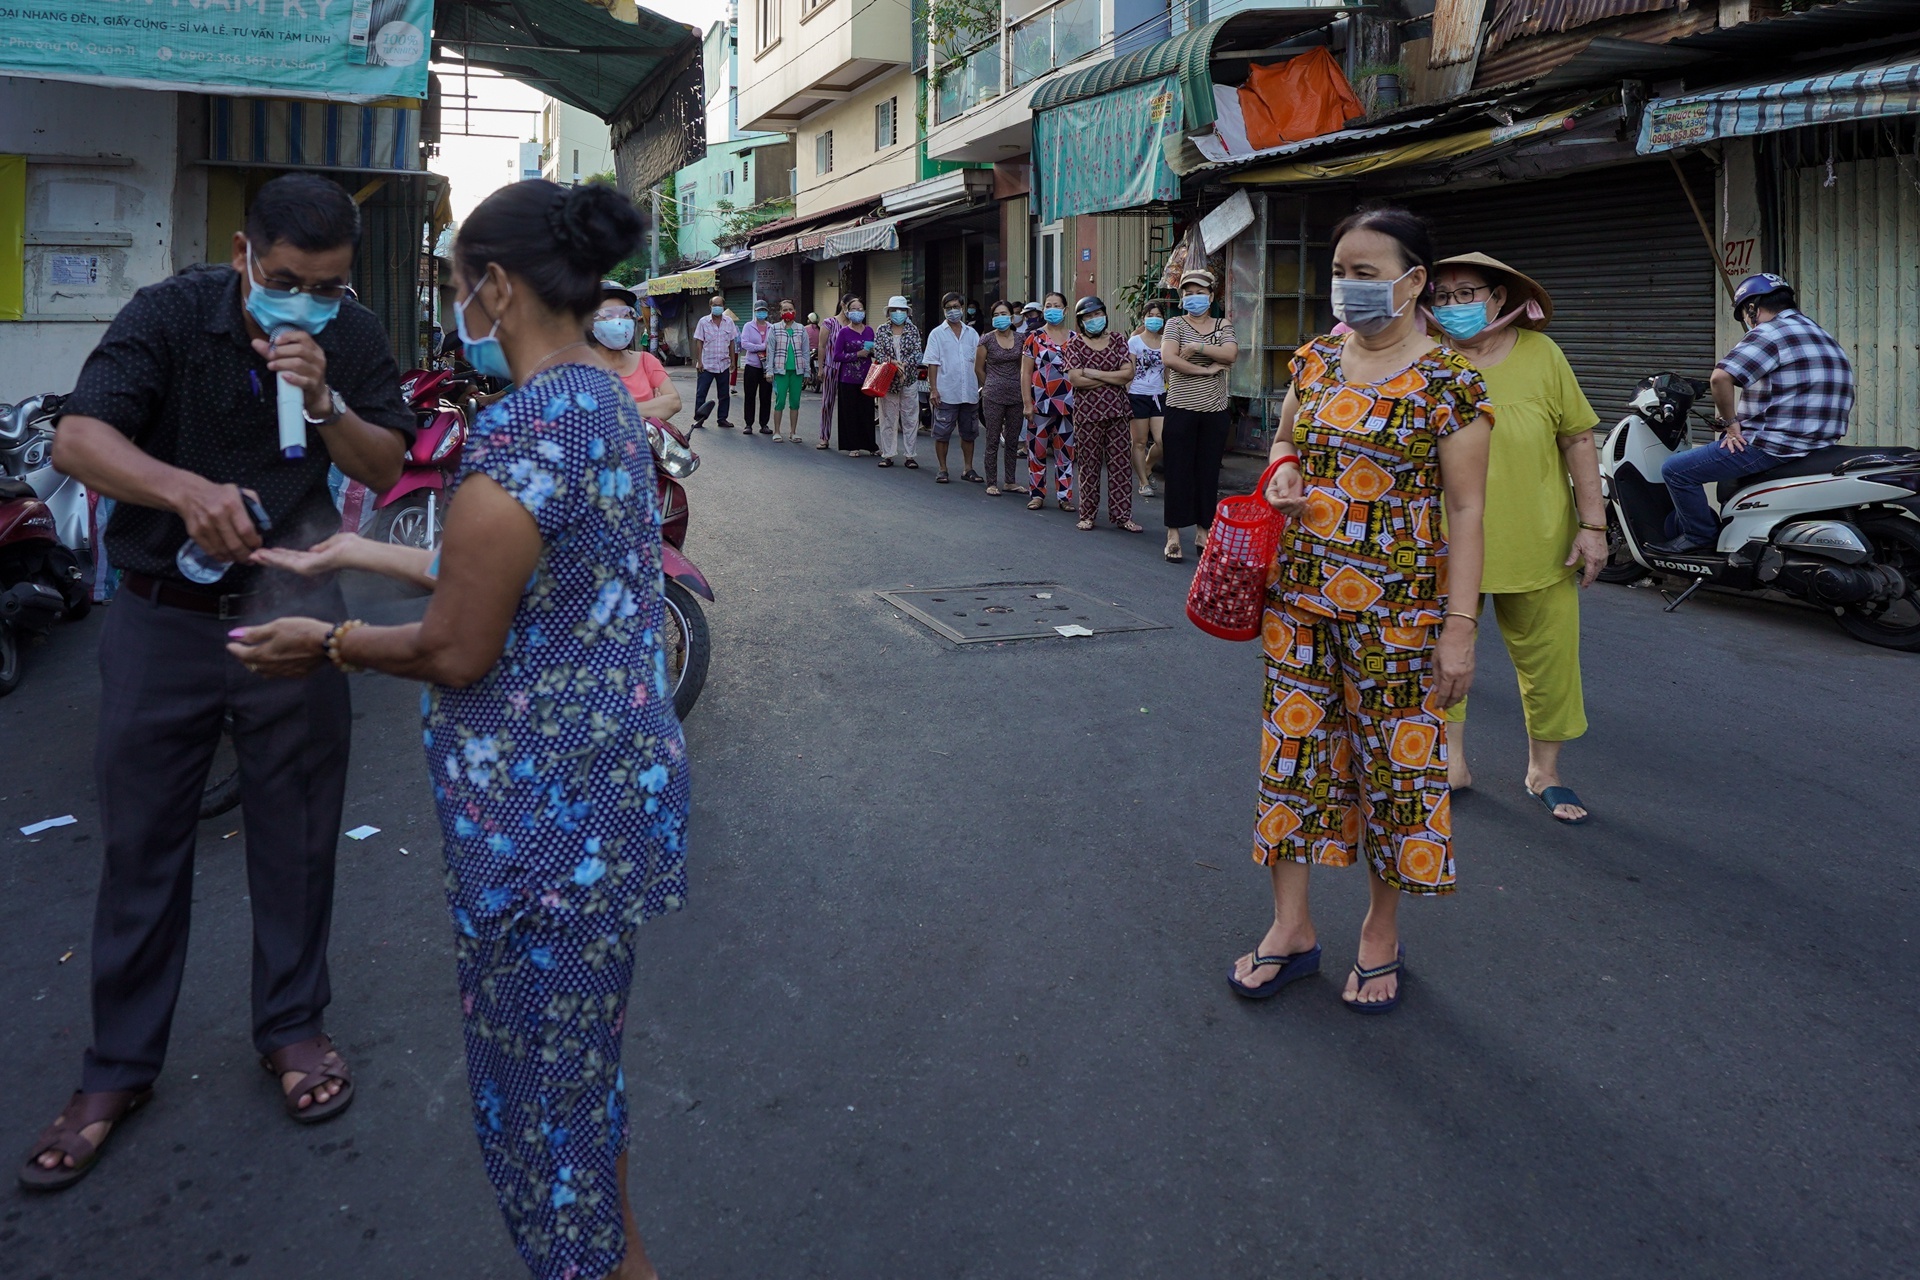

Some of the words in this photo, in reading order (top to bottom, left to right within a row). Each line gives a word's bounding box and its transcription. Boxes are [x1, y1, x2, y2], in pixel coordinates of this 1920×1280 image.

[22, 10, 67, 22] NHANG
[71, 12, 99, 26] ĐÈN,
[103, 14, 131, 26] GIẤY
[134, 17, 167, 29] CÚNG
[193, 24, 209, 34] VÀ
[232, 27, 249, 37] TƯ
[251, 27, 274, 39] VẤN
[305, 34, 331, 44] LINH
[9, 36, 61, 52] Phường
[65, 41, 83, 53] 10,
[86, 42, 122, 55] Quận
[125, 45, 135, 56] 11
[382, 33, 418, 46] 100%
[1725, 238, 1755, 268] 277
[1653, 559, 1713, 575] HONDA
